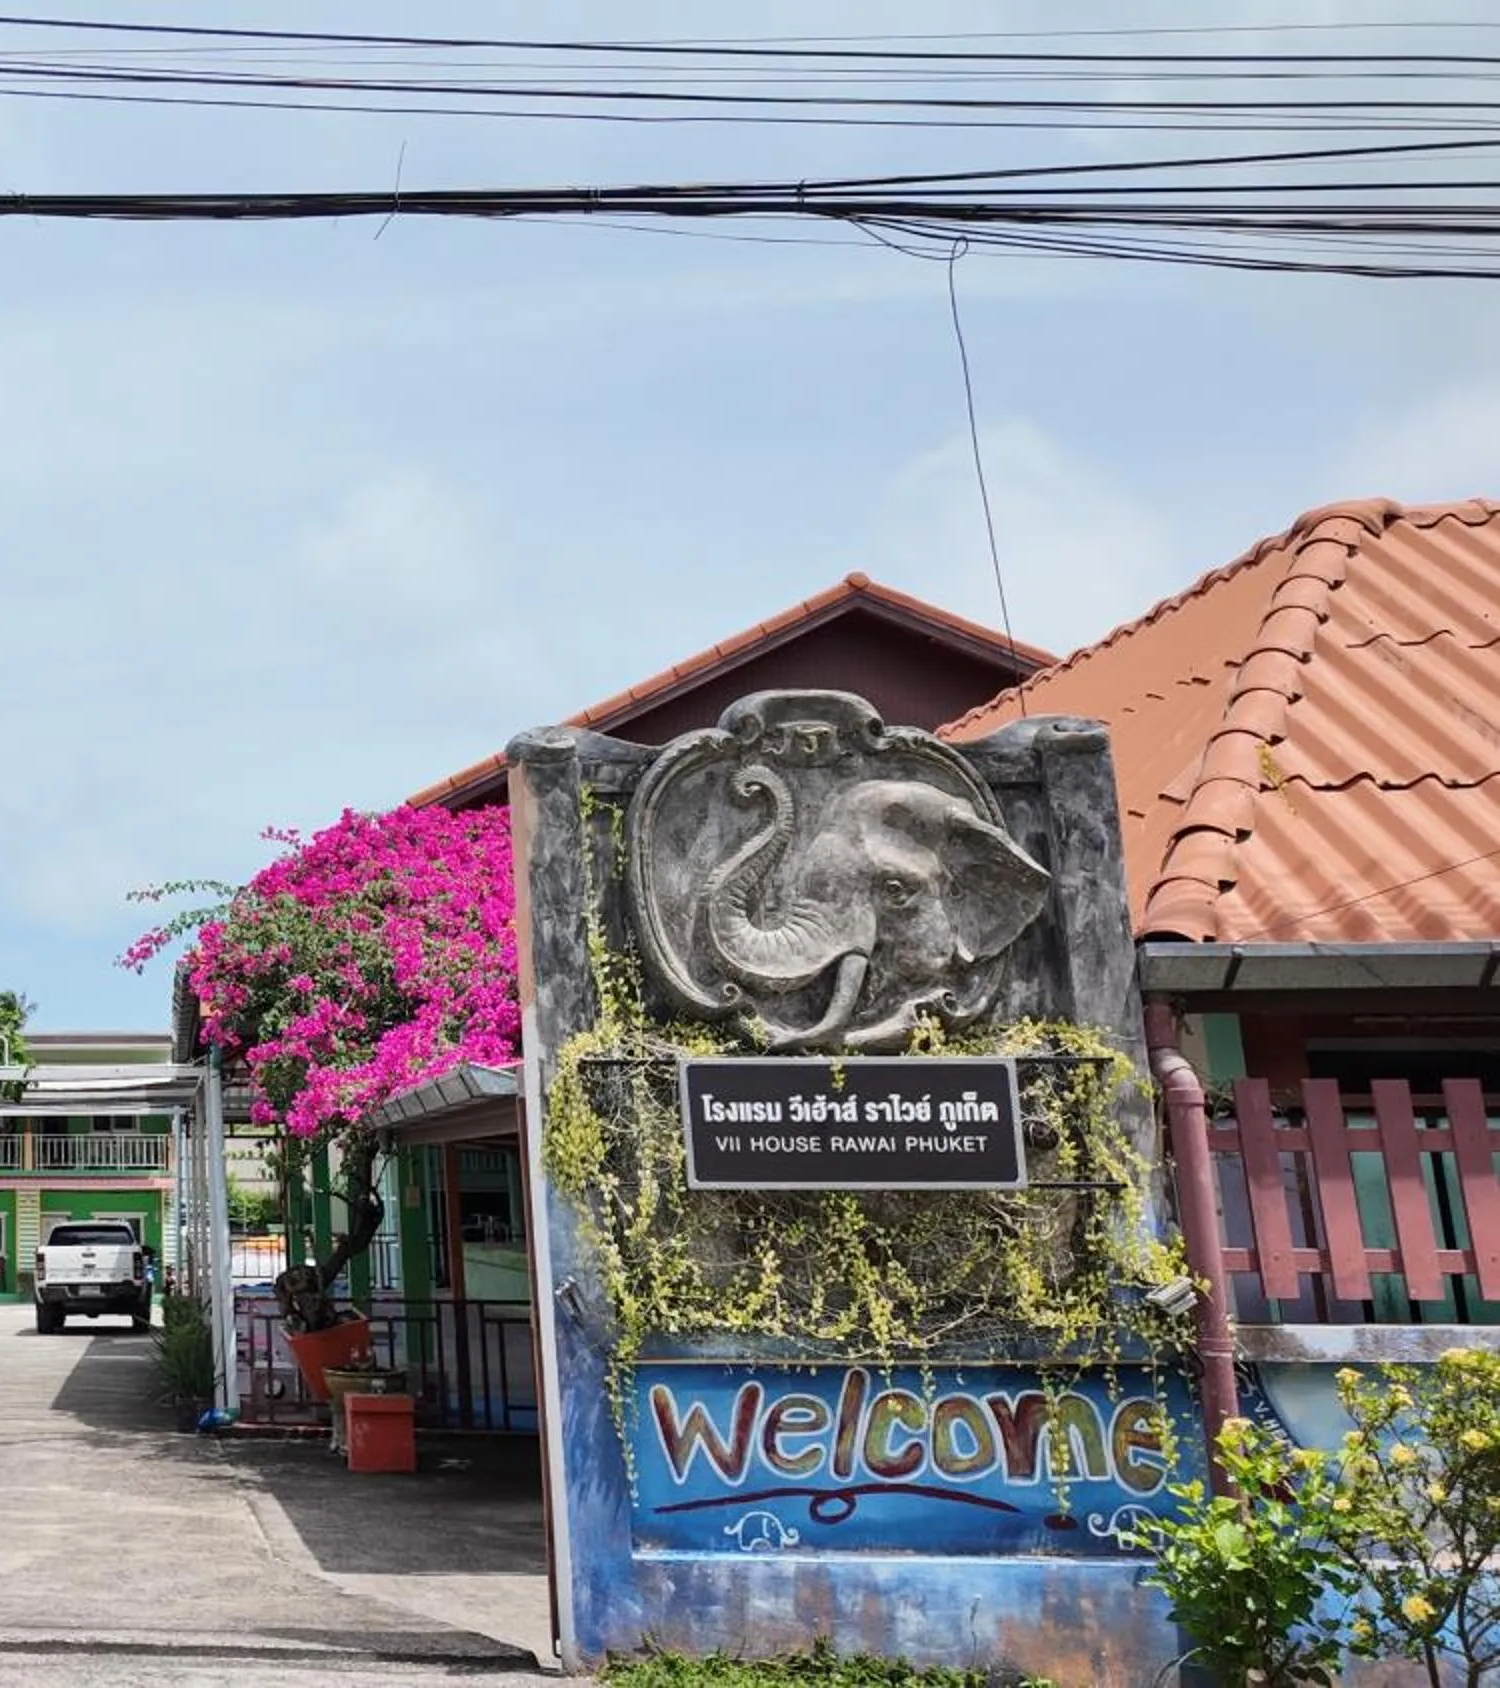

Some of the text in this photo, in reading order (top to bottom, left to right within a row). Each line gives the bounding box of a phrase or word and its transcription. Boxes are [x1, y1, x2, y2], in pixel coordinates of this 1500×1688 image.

[701, 1091, 999, 1132] โรงแรม วีเฮ้าส์ ราไวย์ ภูเก็ต
[715, 1135, 988, 1153] VII HOUSE RAWAI PHUKET
